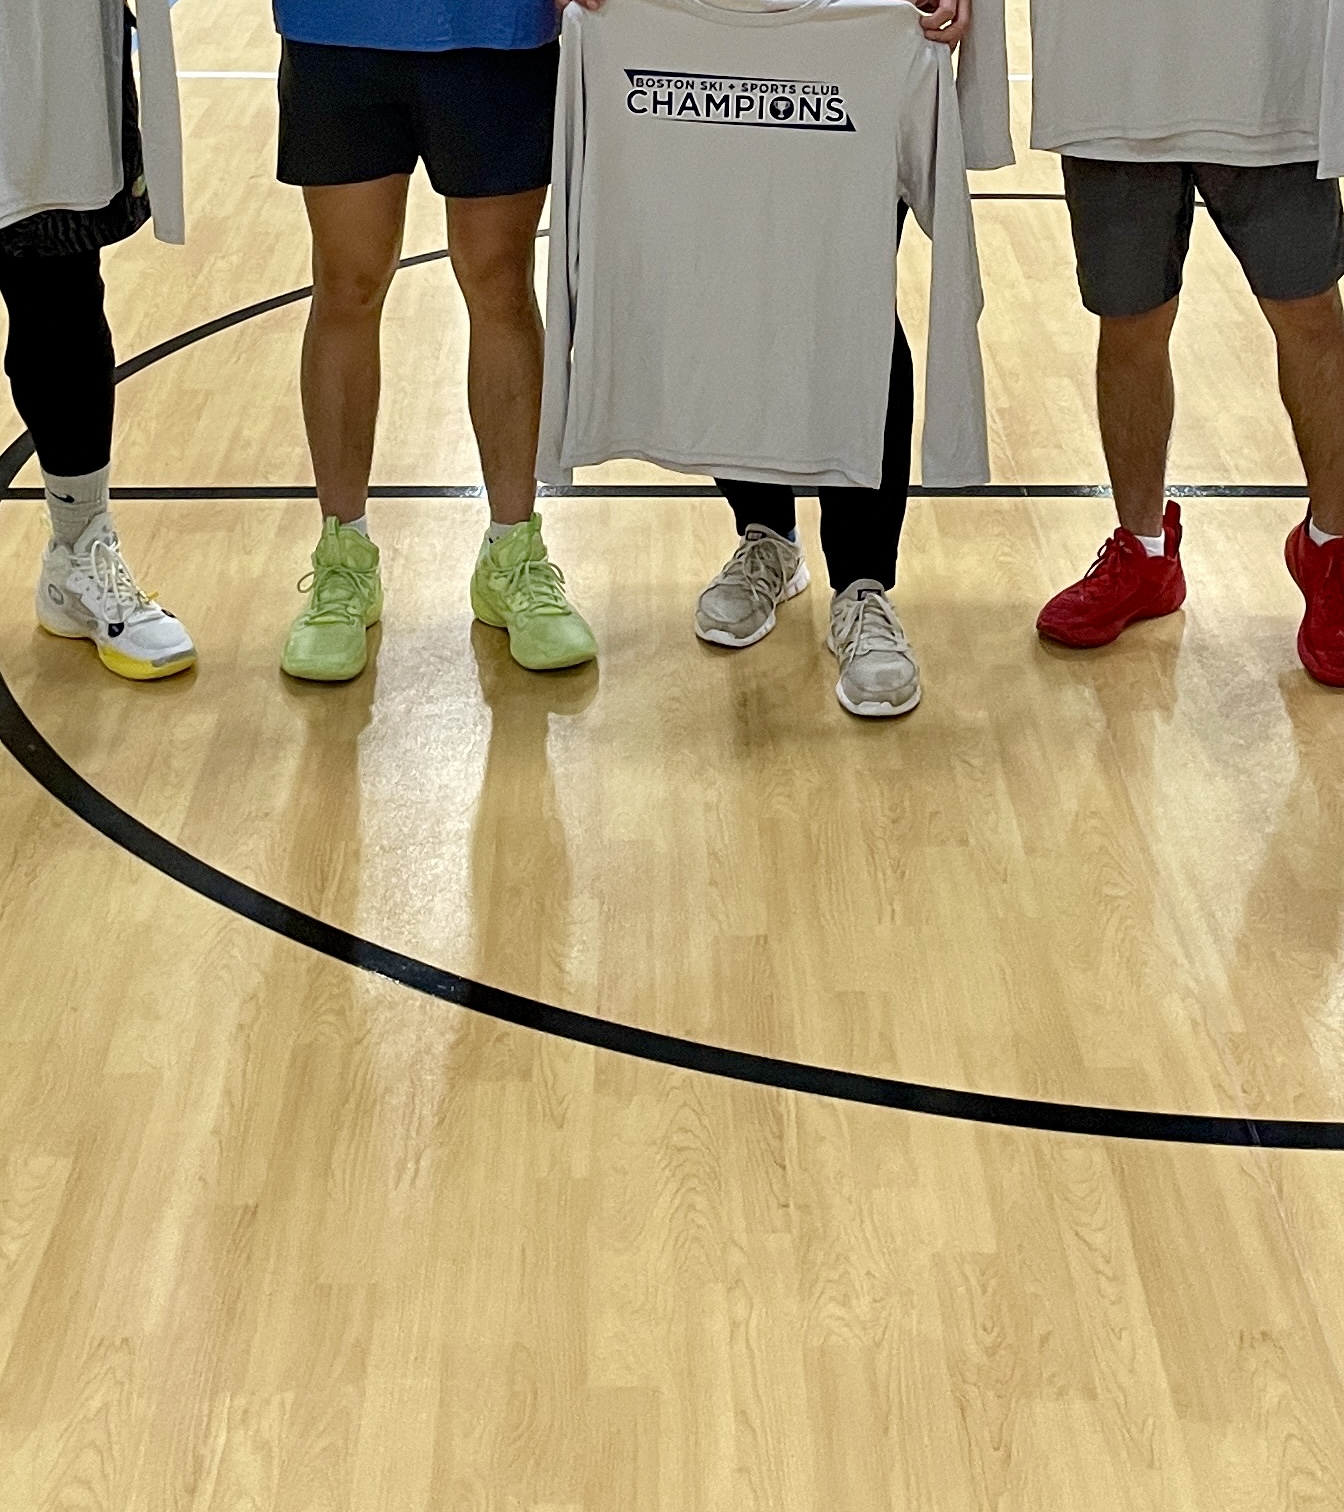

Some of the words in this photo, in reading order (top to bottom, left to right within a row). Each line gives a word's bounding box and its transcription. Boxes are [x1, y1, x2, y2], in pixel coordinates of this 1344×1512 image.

[635, 77, 695, 90] BOSTON
[700, 80, 723, 91] SKI
[740, 82, 796, 94] SPORTS
[802, 84, 840, 96] CLUB
[626, 89, 844, 122] CHAMPIONS
